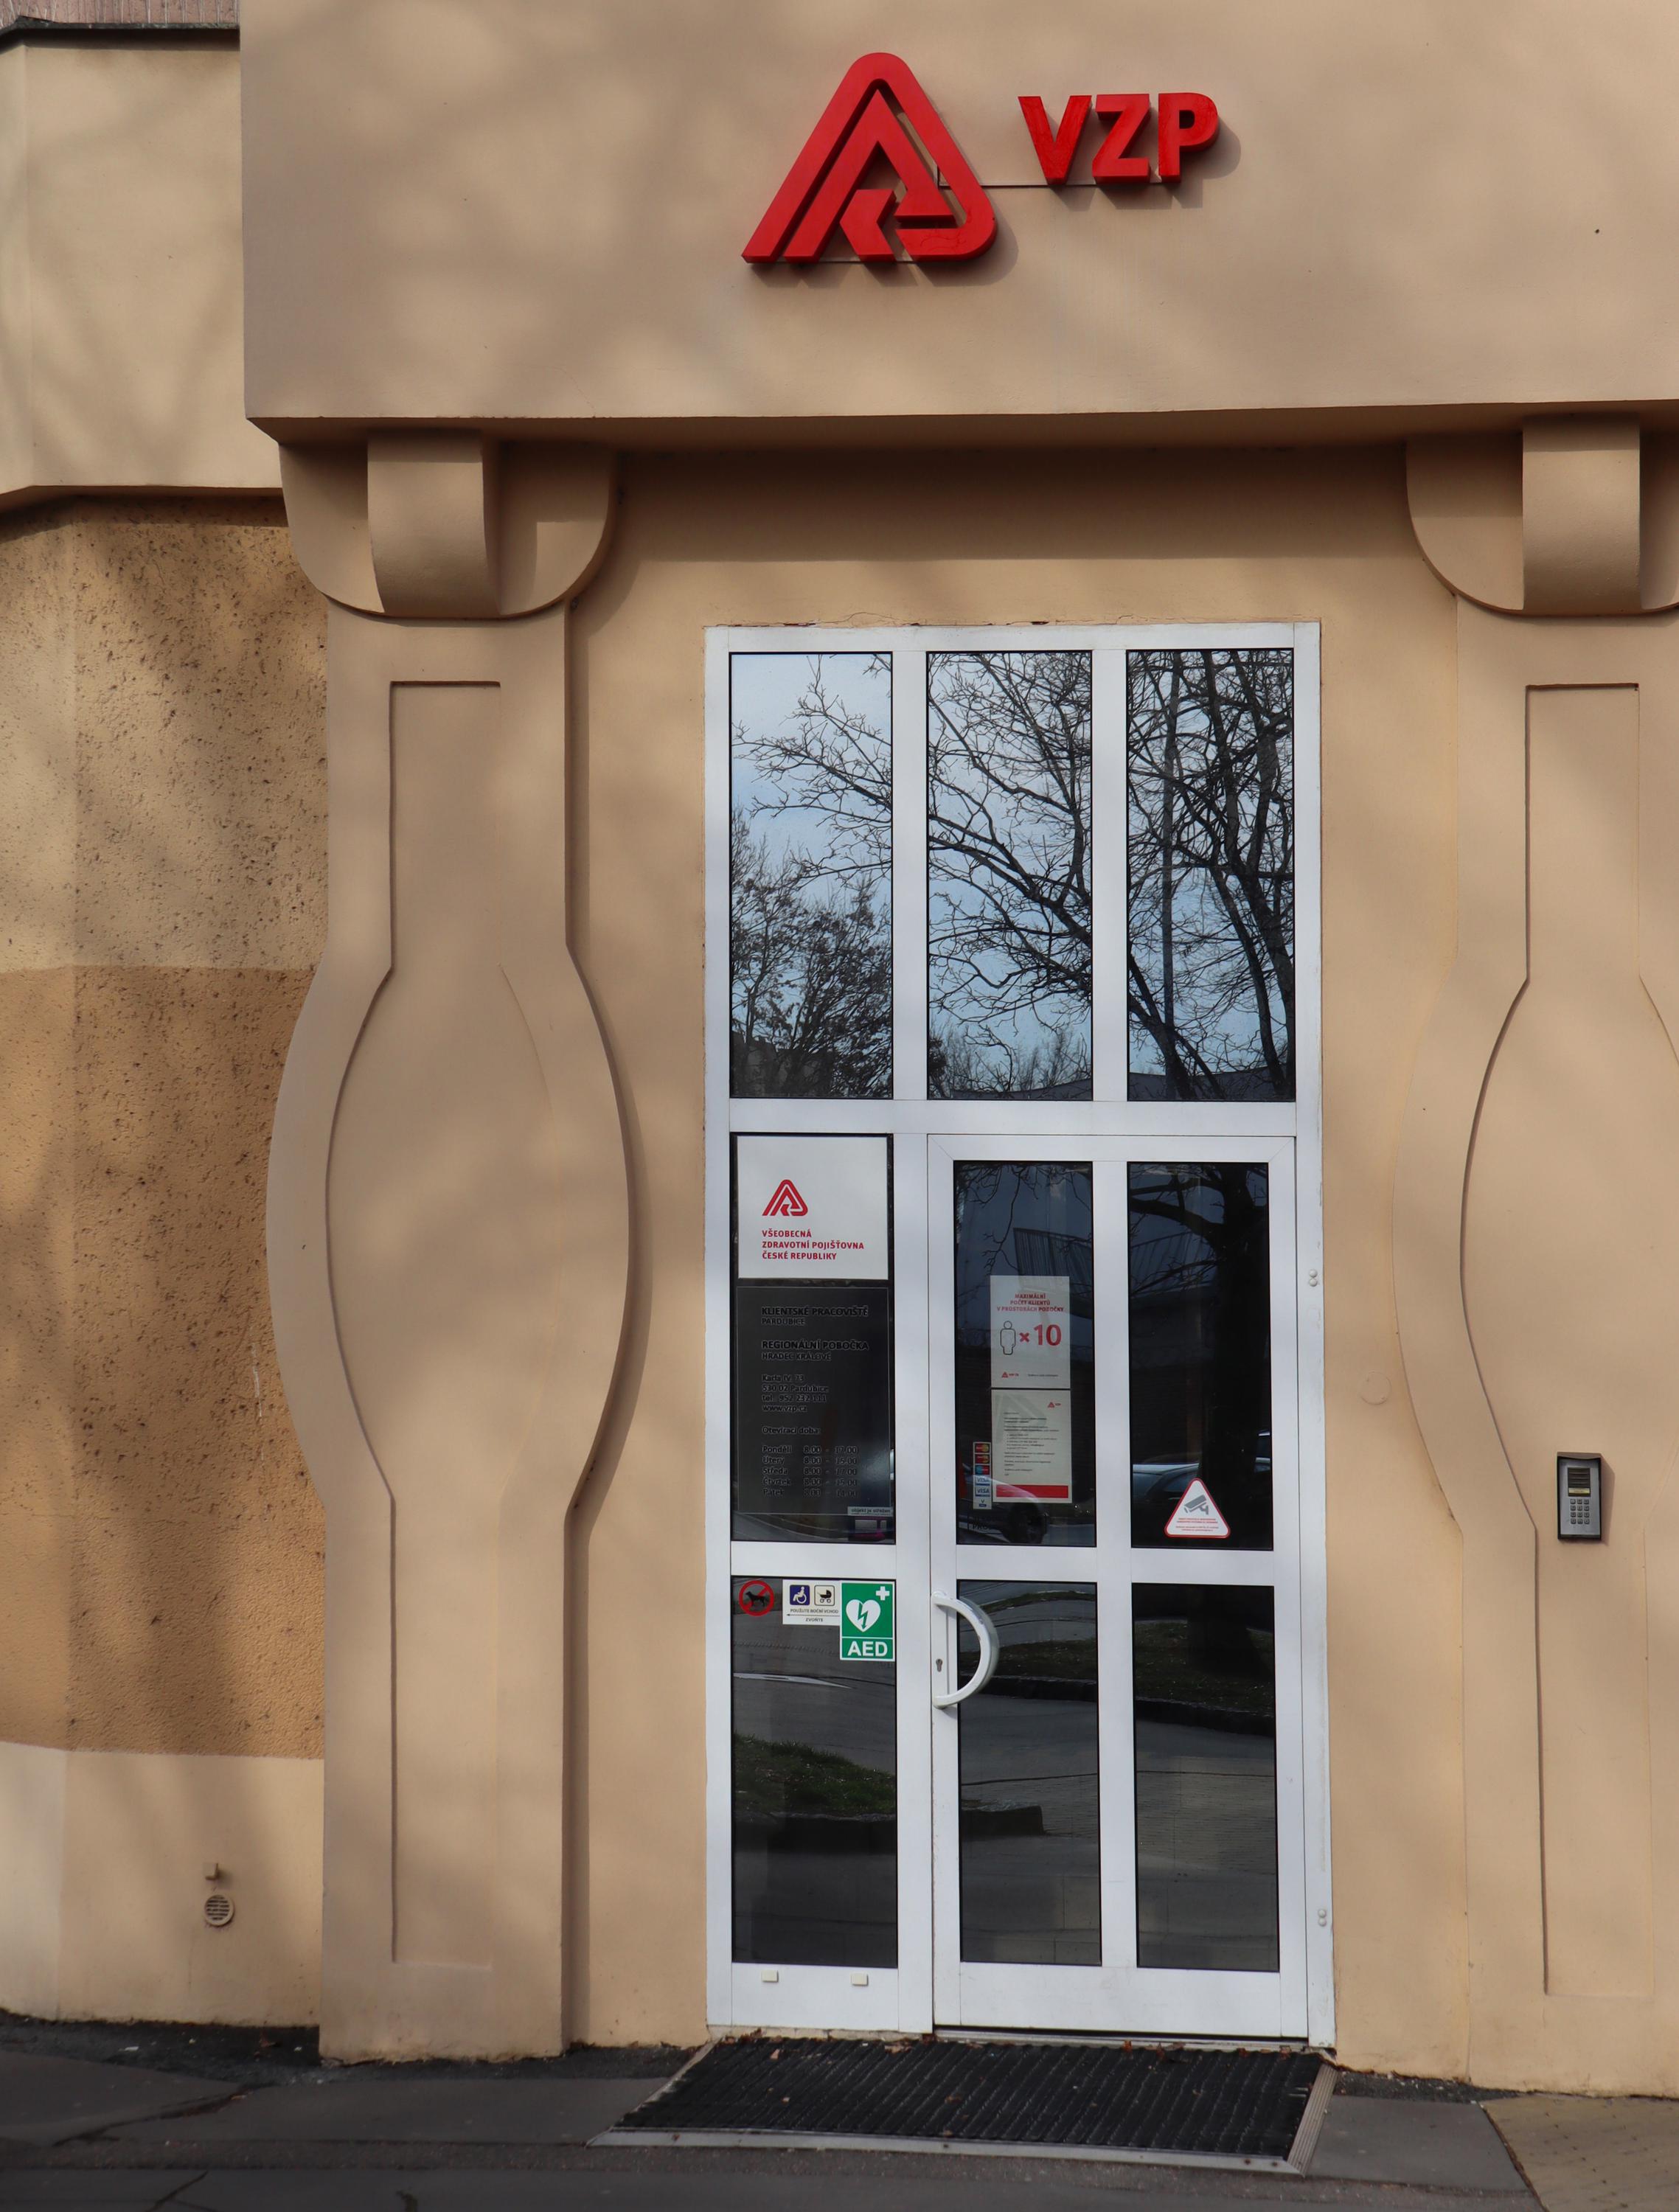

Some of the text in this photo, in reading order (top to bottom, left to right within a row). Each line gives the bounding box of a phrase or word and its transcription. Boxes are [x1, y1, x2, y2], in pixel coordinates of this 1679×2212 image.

[1018, 92, 1220, 185] VZP
[762, 1228, 812, 1237] VŠEOBECNÁ
[762, 1239, 864, 1250] ZDRAVOTNÍ POJIŠŤOVNA
[762, 1250, 837, 1260] ČESKÉ REPUBLIKY
[761, 1305, 869, 1316] KLIENTSKÉ PRACOVIŠTĚ
[761, 1318, 806, 1326] PARDUBICE
[1033, 1324, 1062, 1346] 10
[762, 1338, 869, 1350] REGIONÁLNÍ POBOČKA
[762, 1352, 832, 1360] HRADEC KRÁLOVÉ
[762, 1384, 830, 1393] 530 02 Pardubice
[762, 1405, 807, 1413] www.vzp.cz
[762, 1445, 792, 1453] Pondělí
[847, 1641, 888, 1656] AED
